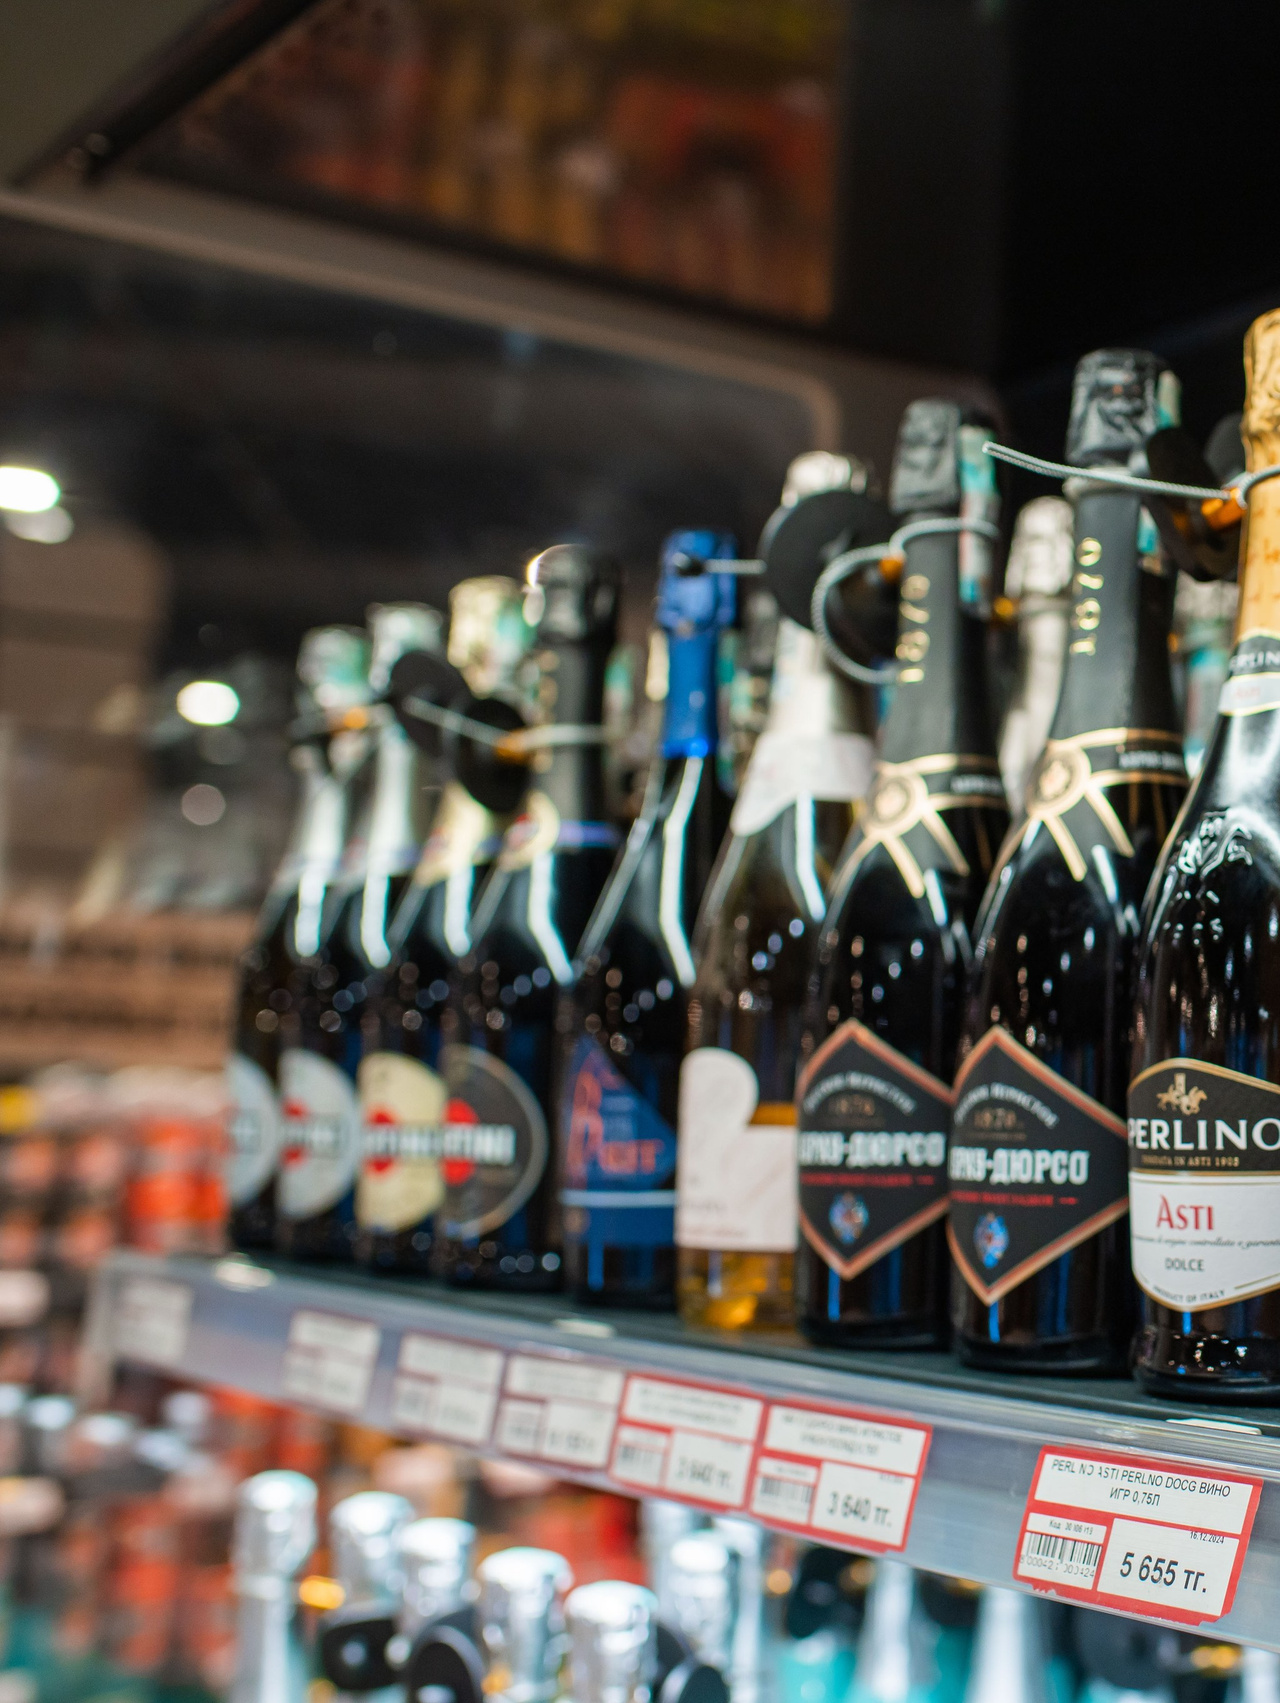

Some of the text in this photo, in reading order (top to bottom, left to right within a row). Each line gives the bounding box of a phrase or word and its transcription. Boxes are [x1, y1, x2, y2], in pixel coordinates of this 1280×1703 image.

[1165, 1258, 1205, 1272] DOLCE
[1109, 1487, 1161, 1507] ИГР 0,75Л
[1165, 1476, 1197, 1492] DOCG
[1199, 1481, 1231, 1498] ВИНО
[1119, 1552, 1135, 1578] 5
[1138, 1555, 1179, 1587] 655
